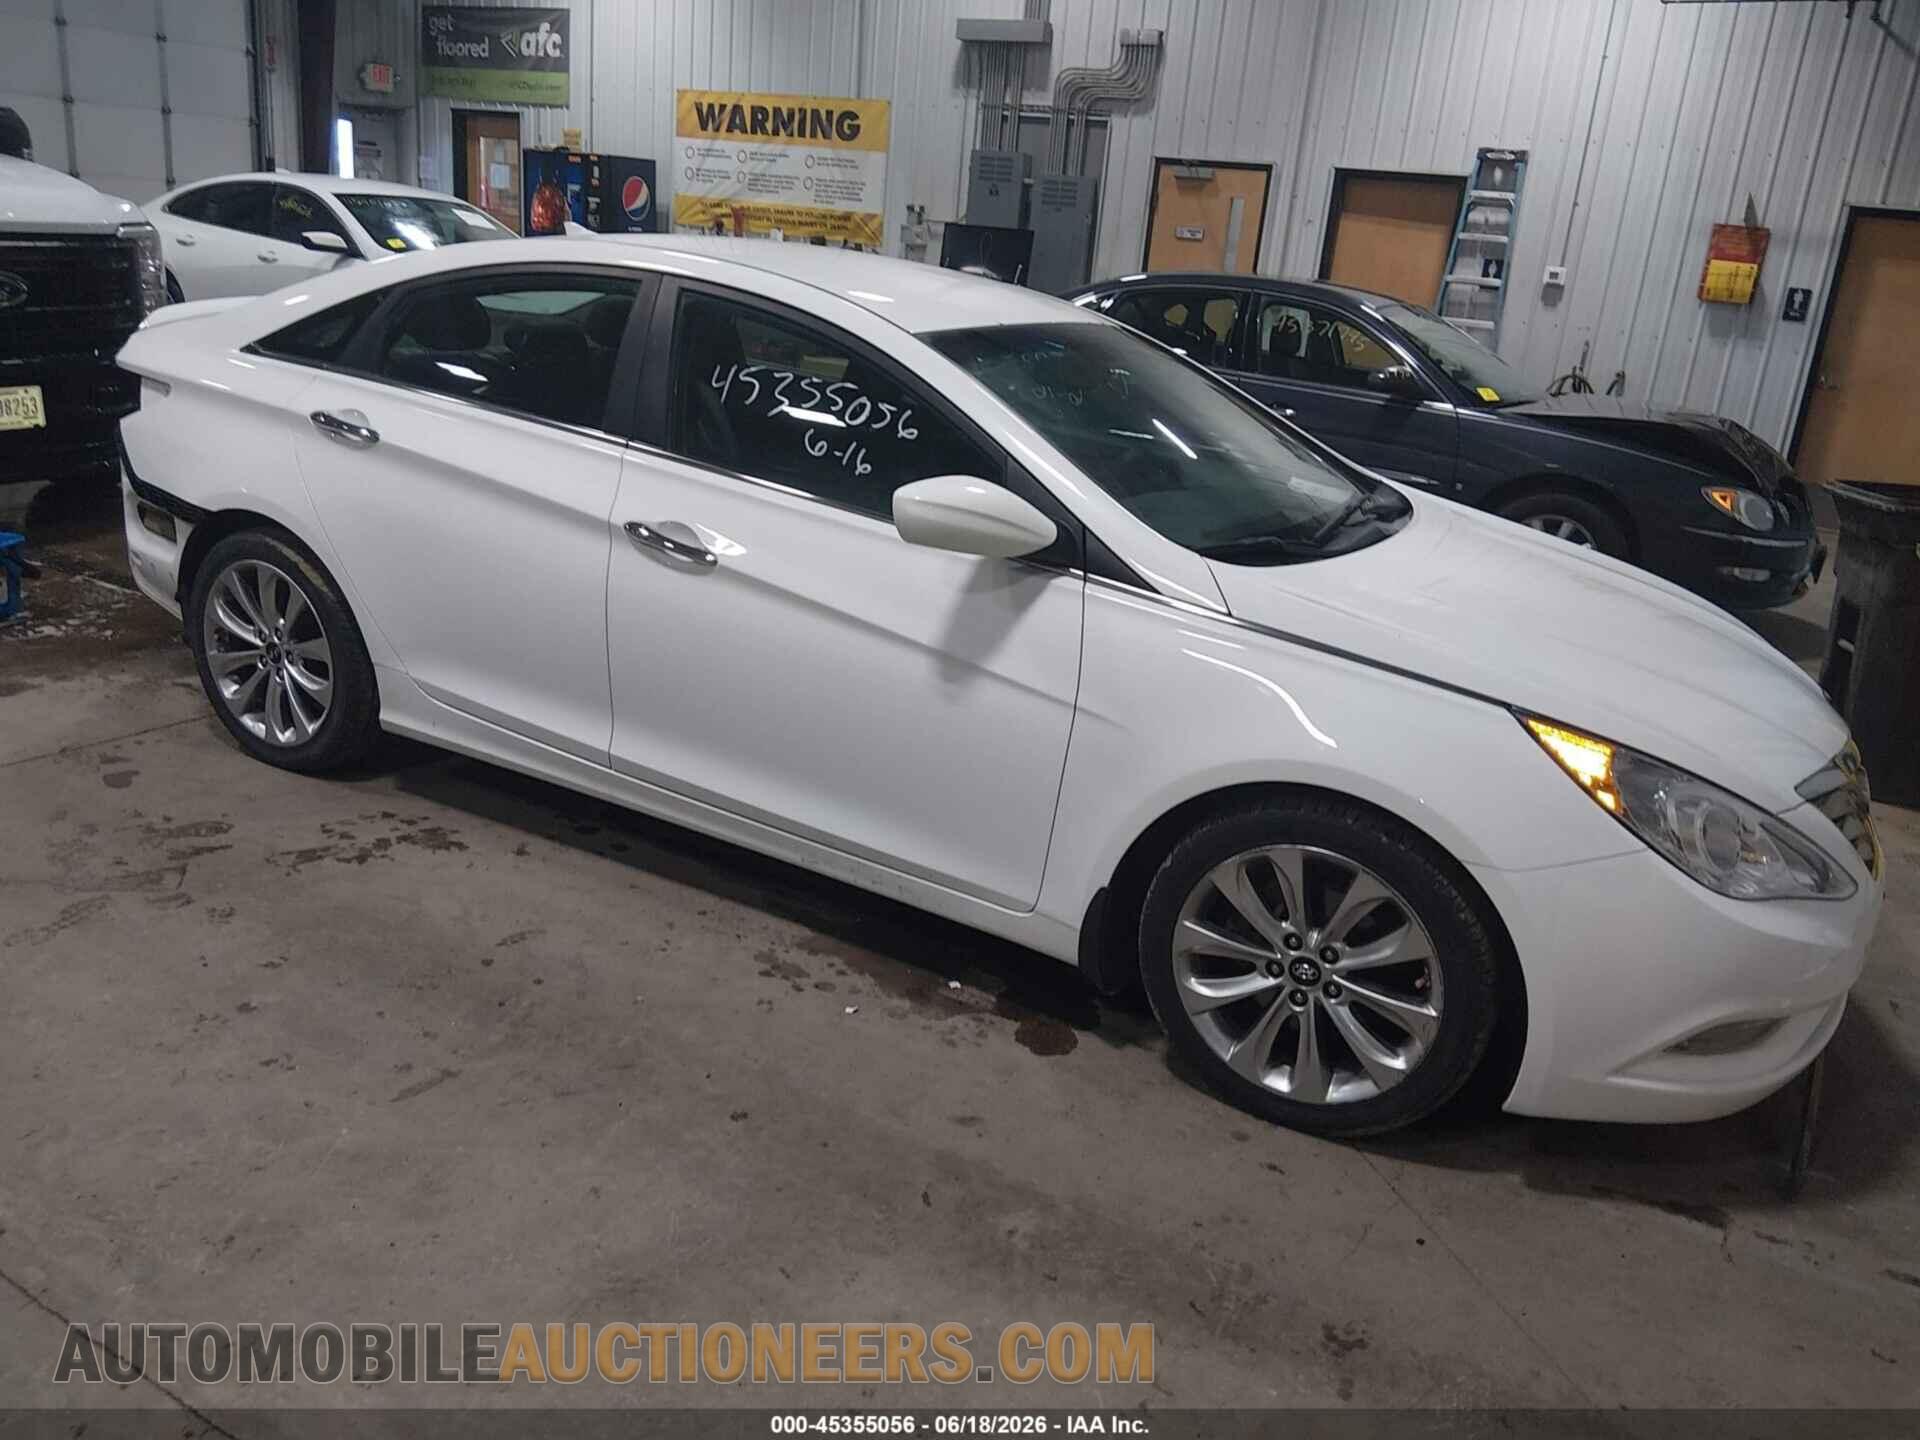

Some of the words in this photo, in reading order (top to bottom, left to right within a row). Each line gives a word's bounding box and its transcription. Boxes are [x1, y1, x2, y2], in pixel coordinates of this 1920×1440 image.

[428, 14, 454, 36] get
[520, 22, 562, 58] afc
[436, 34, 489, 58] floored
[694, 101, 861, 142] WARNING
[711, 364, 919, 439] 45355056
[804, 428, 872, 475] 6-16
